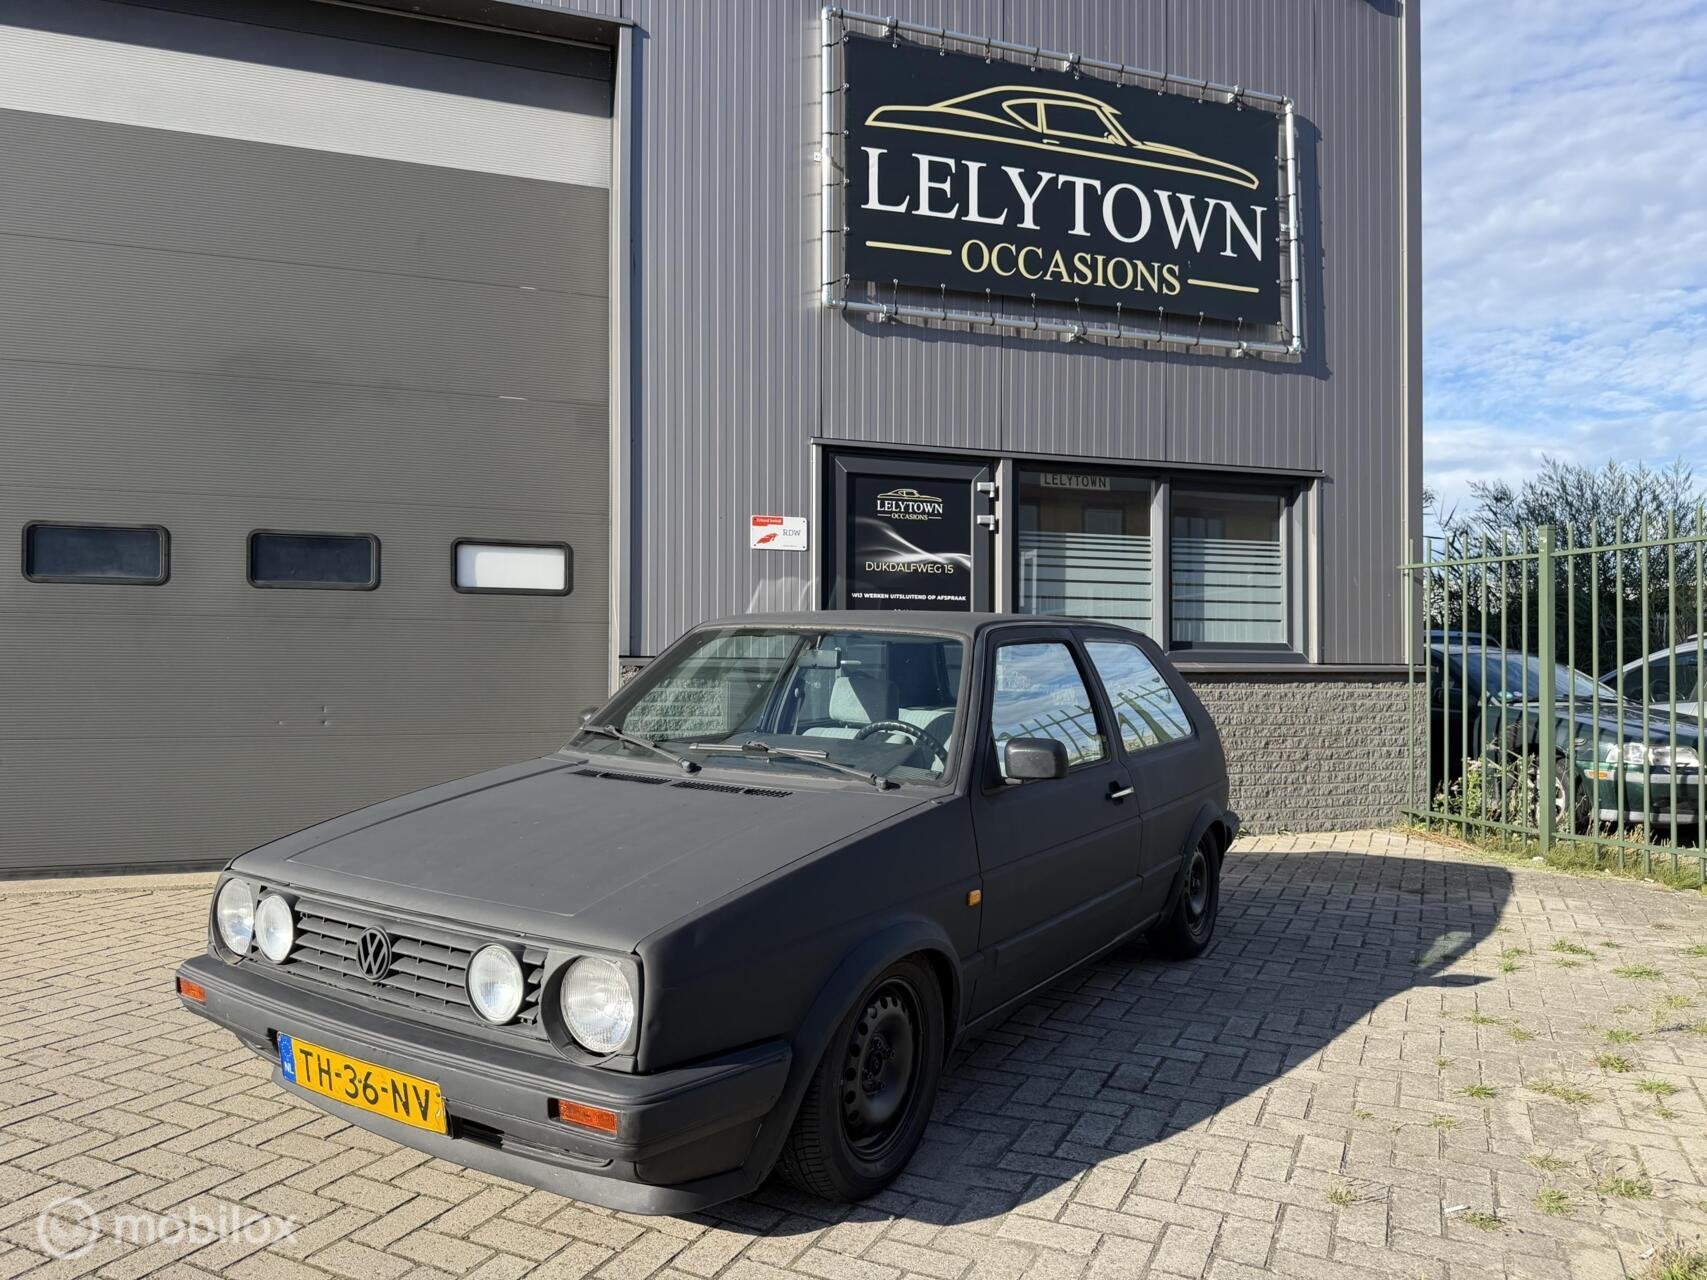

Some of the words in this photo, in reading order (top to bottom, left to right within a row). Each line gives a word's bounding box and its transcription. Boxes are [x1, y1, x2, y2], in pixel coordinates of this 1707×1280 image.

[861, 146, 1267, 262] LELYTOWN
[961, 239, 1181, 296] OCCASIONS
[1044, 473, 1107, 489] LELYTOWN
[877, 500, 943, 514] LELYTOWN
[891, 512, 929, 521] OCCASIONS
[865, 561, 942, 574] DUKDALFWEG
[944, 564, 954, 574] 15
[284, 1061, 295, 1075] NL
[300, 1048, 430, 1122] TH-36-NV
